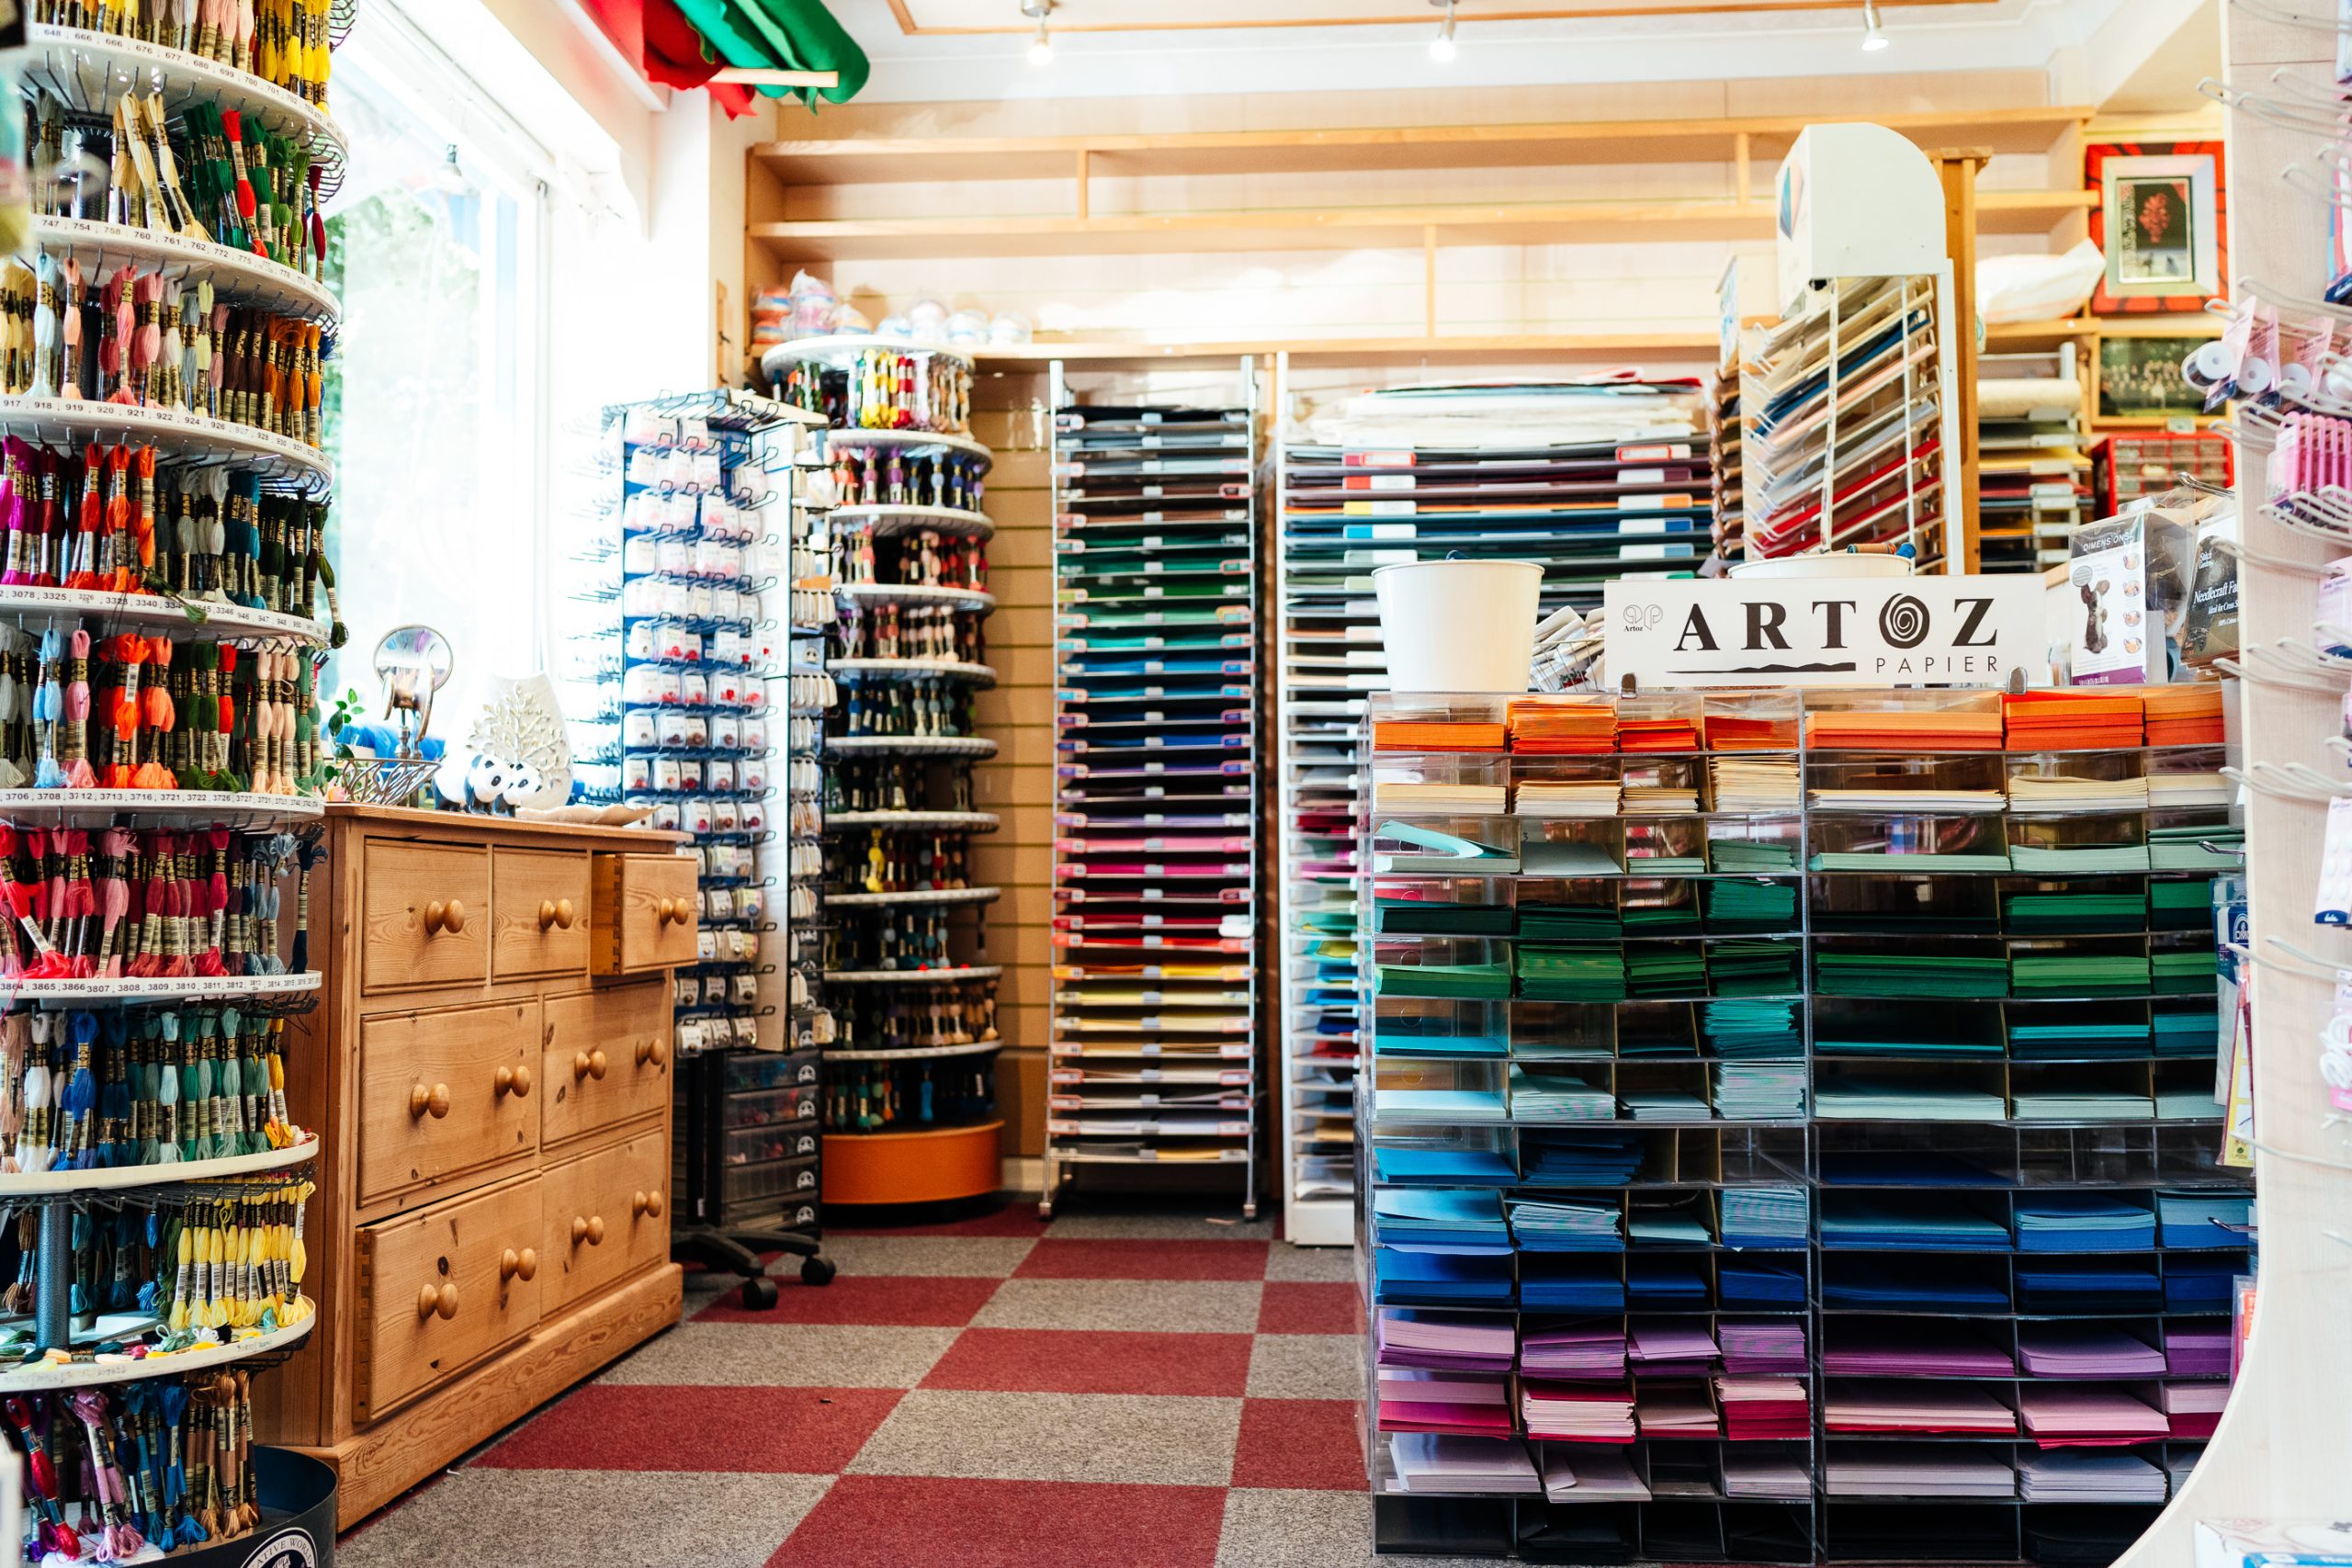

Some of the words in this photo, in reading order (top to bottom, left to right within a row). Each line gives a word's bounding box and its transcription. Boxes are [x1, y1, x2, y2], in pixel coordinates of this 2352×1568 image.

[165, 51, 182, 61] 677
[220, 68, 234, 78] 699
[42, 220, 59, 228] 747
[74, 222, 90, 231] 754
[134, 231, 151, 241] 760
[164, 236, 180, 245] 761
[191, 242, 206, 252] 762
[214, 248, 229, 258] 772
[34, 401, 52, 410] 918
[65, 403, 84, 412] 919
[96, 406, 115, 414] 920
[127, 409, 145, 417] 921
[156, 412, 173, 421] 922
[185, 416, 199, 425] 924
[210, 422, 225, 430] 926
[2083, 533, 2131, 551] DIMENSONS
[43, 592, 66, 600] 3325
[136, 599, 157, 607] 3340
[216, 607, 234, 615] 3346
[2194, 582, 2228, 604] Needlecraft
[237, 612, 249, 620] 946
[258, 615, 269, 623] 947
[1673, 592, 1997, 651] ARTOZ
[1876, 656, 1997, 674] PAPIER
[69, 792, 92, 800] 3712
[213, 794, 231, 802] 3726
[236, 795, 252, 803] 3727
[87, 985, 109, 993] 3807
[118, 984, 140, 992] 3808
[148, 983, 169, 991] 3809
[175, 982, 196, 990] 3810
